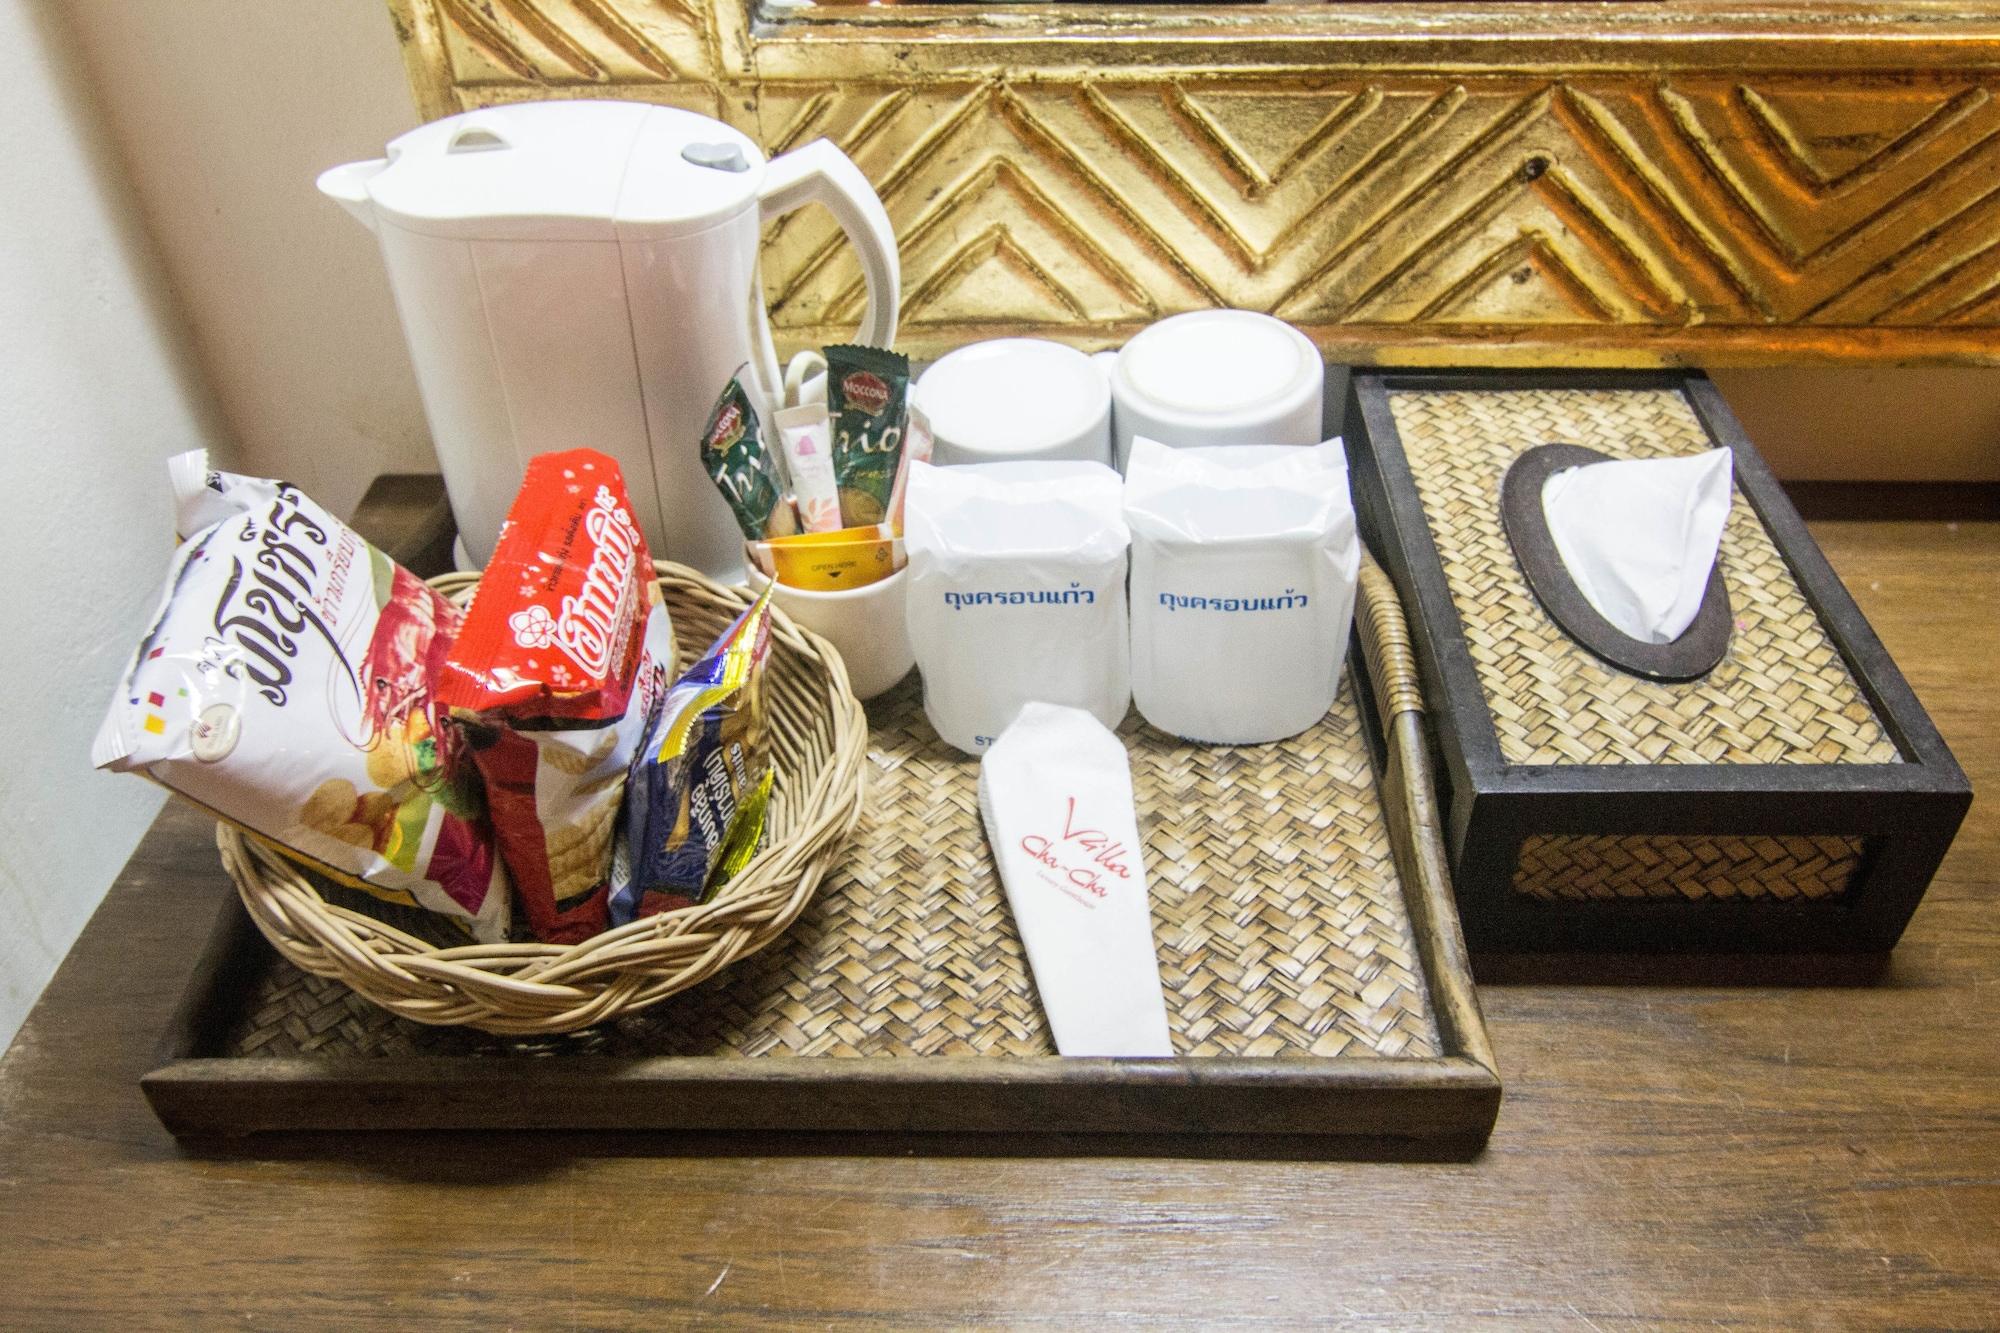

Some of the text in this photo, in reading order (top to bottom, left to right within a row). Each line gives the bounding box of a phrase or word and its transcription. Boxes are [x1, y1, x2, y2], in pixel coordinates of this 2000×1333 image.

[944, 582, 1095, 611] ถุงครอบแก้ว
[1159, 588, 1309, 612] ถุงครอบแก้ว
[731, 742, 749, 790] anuts
[691, 782, 721, 850] อบเกลือ
[1021, 835, 1108, 898] Cha-Cha
